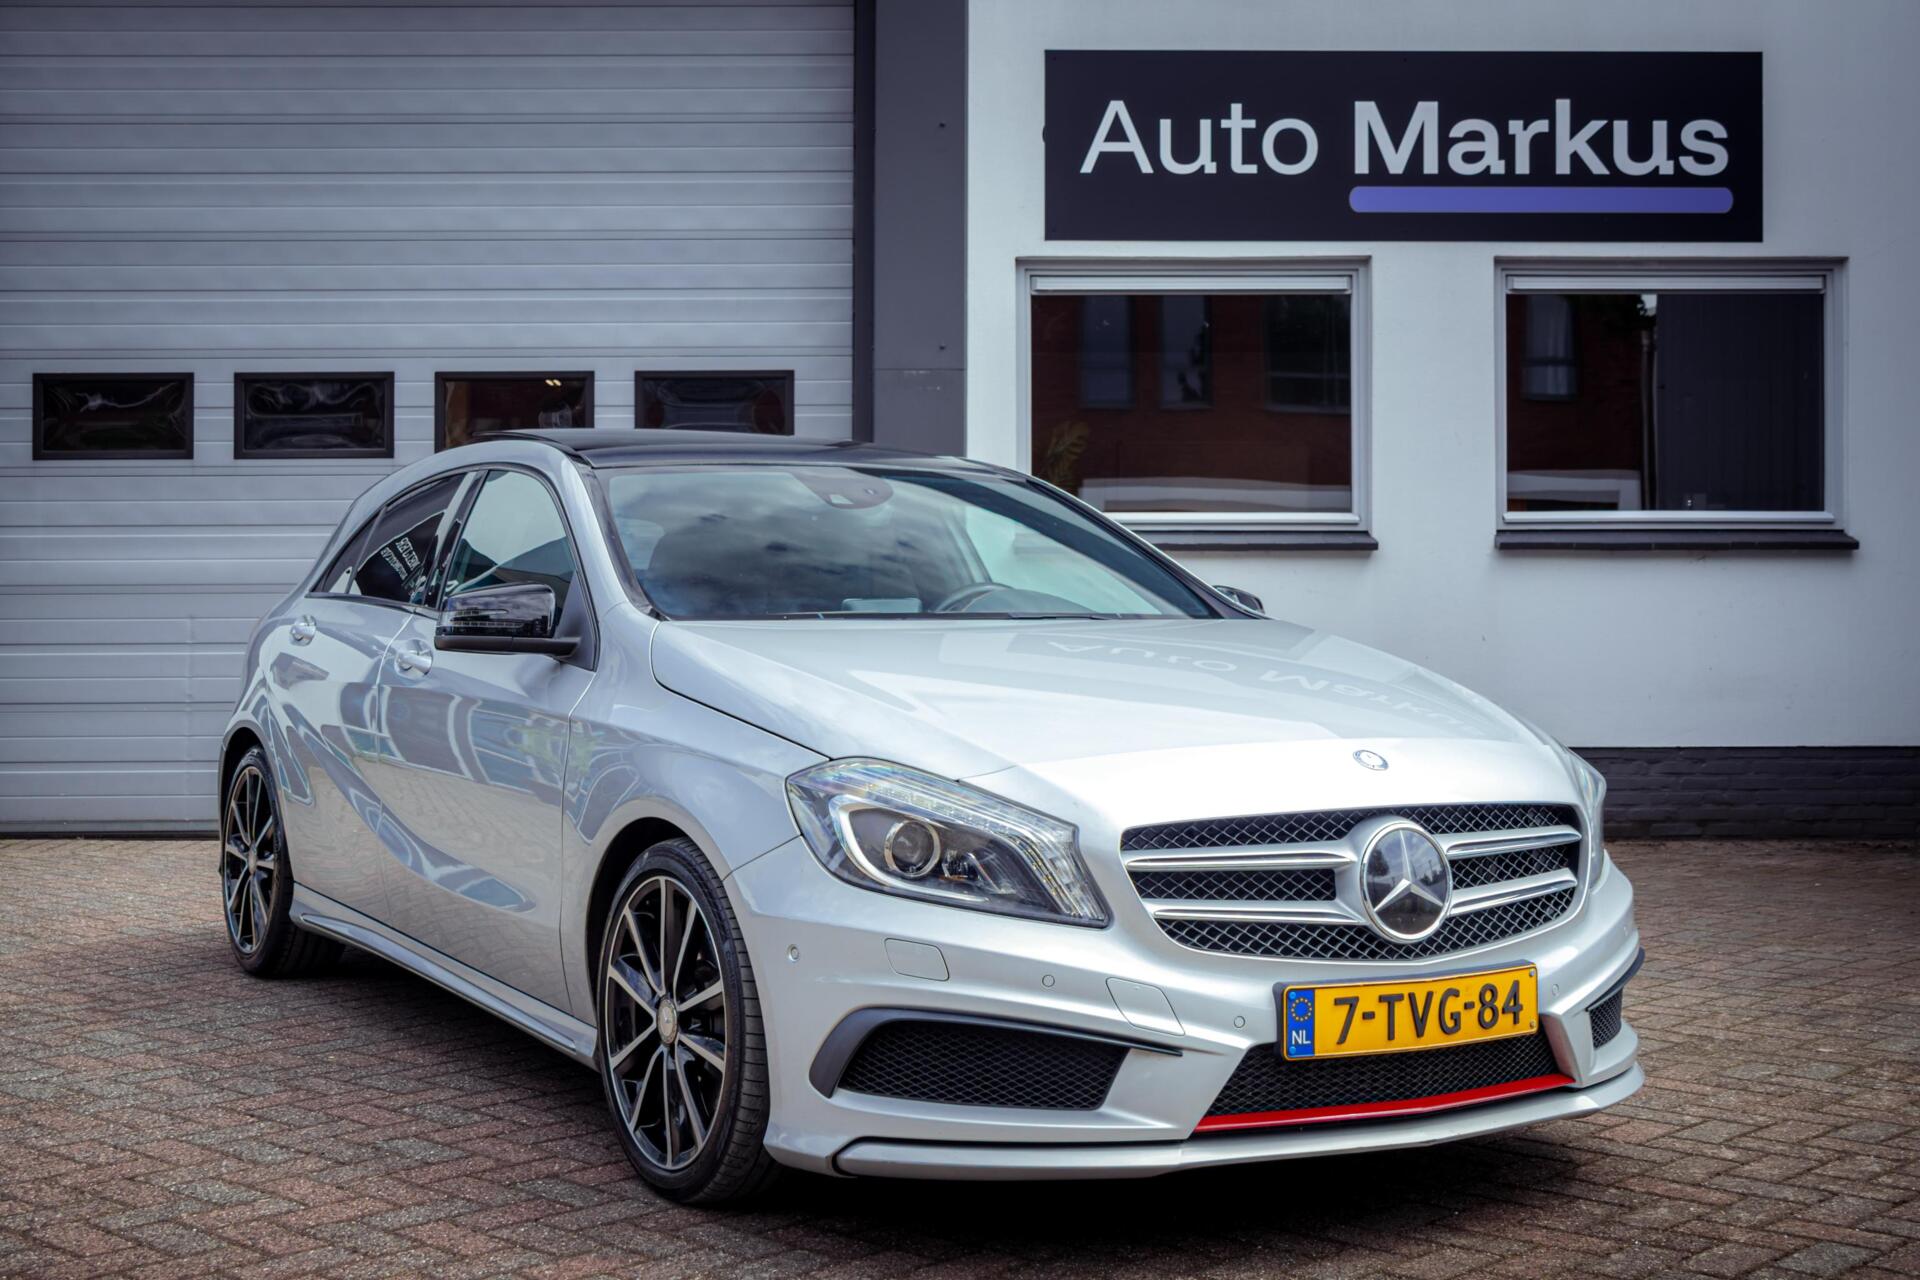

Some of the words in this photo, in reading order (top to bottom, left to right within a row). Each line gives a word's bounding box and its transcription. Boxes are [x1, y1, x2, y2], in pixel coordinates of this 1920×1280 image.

[1080, 100, 1318, 175] Auto
[1354, 98, 1729, 175] Markus
[1291, 1030, 1311, 1045] NL
[1334, 980, 1523, 1045] 7-TVG-84
